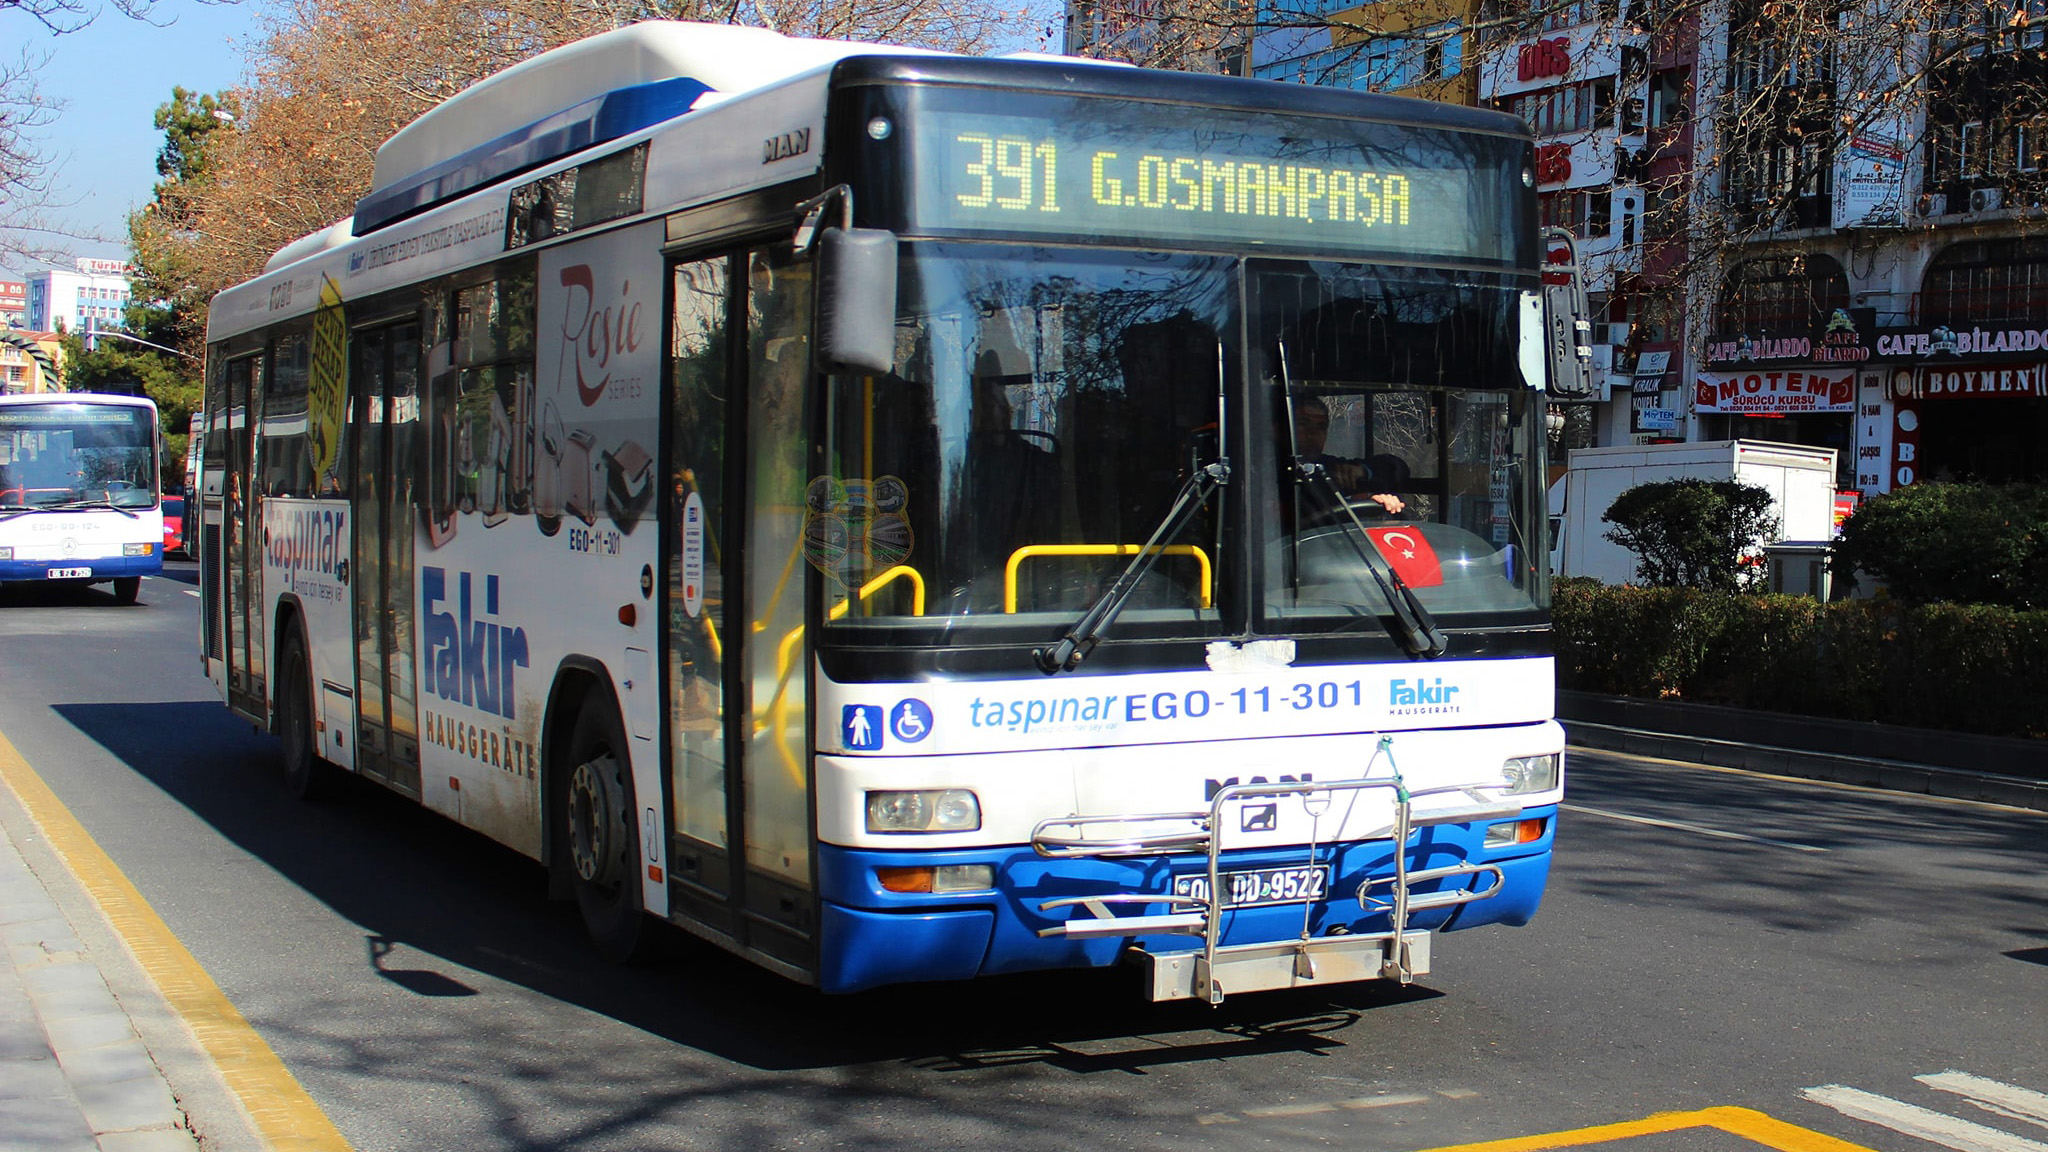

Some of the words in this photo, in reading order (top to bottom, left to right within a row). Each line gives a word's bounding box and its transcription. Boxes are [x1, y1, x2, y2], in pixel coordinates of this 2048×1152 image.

[1518, 37, 1570, 82] DGS
[762, 127, 810, 165] MAN
[957, 133, 1060, 212] 391
[1092, 151, 1409, 228] G.OSMANPAŞA
[558, 264, 644, 407] Rosie
[1707, 341, 1738, 362] CAFE
[1753, 334, 1811, 360] BİLARDO
[1825, 332, 1856, 345] CAFE
[1877, 334, 1930, 355] CAFE
[1813, 345, 1870, 363] BİLARDO
[608, 377, 642, 400] SERIES
[1719, 372, 1830, 400] MOTEM
[1929, 369, 2031, 393] BOYMEN
[1733, 394, 1775, 406] SÜRÜCÜ
[1778, 395, 1816, 405] KURSU
[268, 509, 344, 592] taşpınar
[570, 528, 620, 555] EGO-11-301
[422, 565, 530, 720] Fakir
[1125, 680, 1361, 722] EGO-11-301
[1390, 678, 1460, 705] Fakir
[970, 694, 1118, 733] taşpınar
[1389, 706, 1461, 715] HAUSGERÄTE
[1105, 722, 1119, 730] var
[426, 710, 535, 780] HAUSGERÄTE
[1232, 872, 1261, 903] DD
[1270, 869, 1325, 900] 9522
